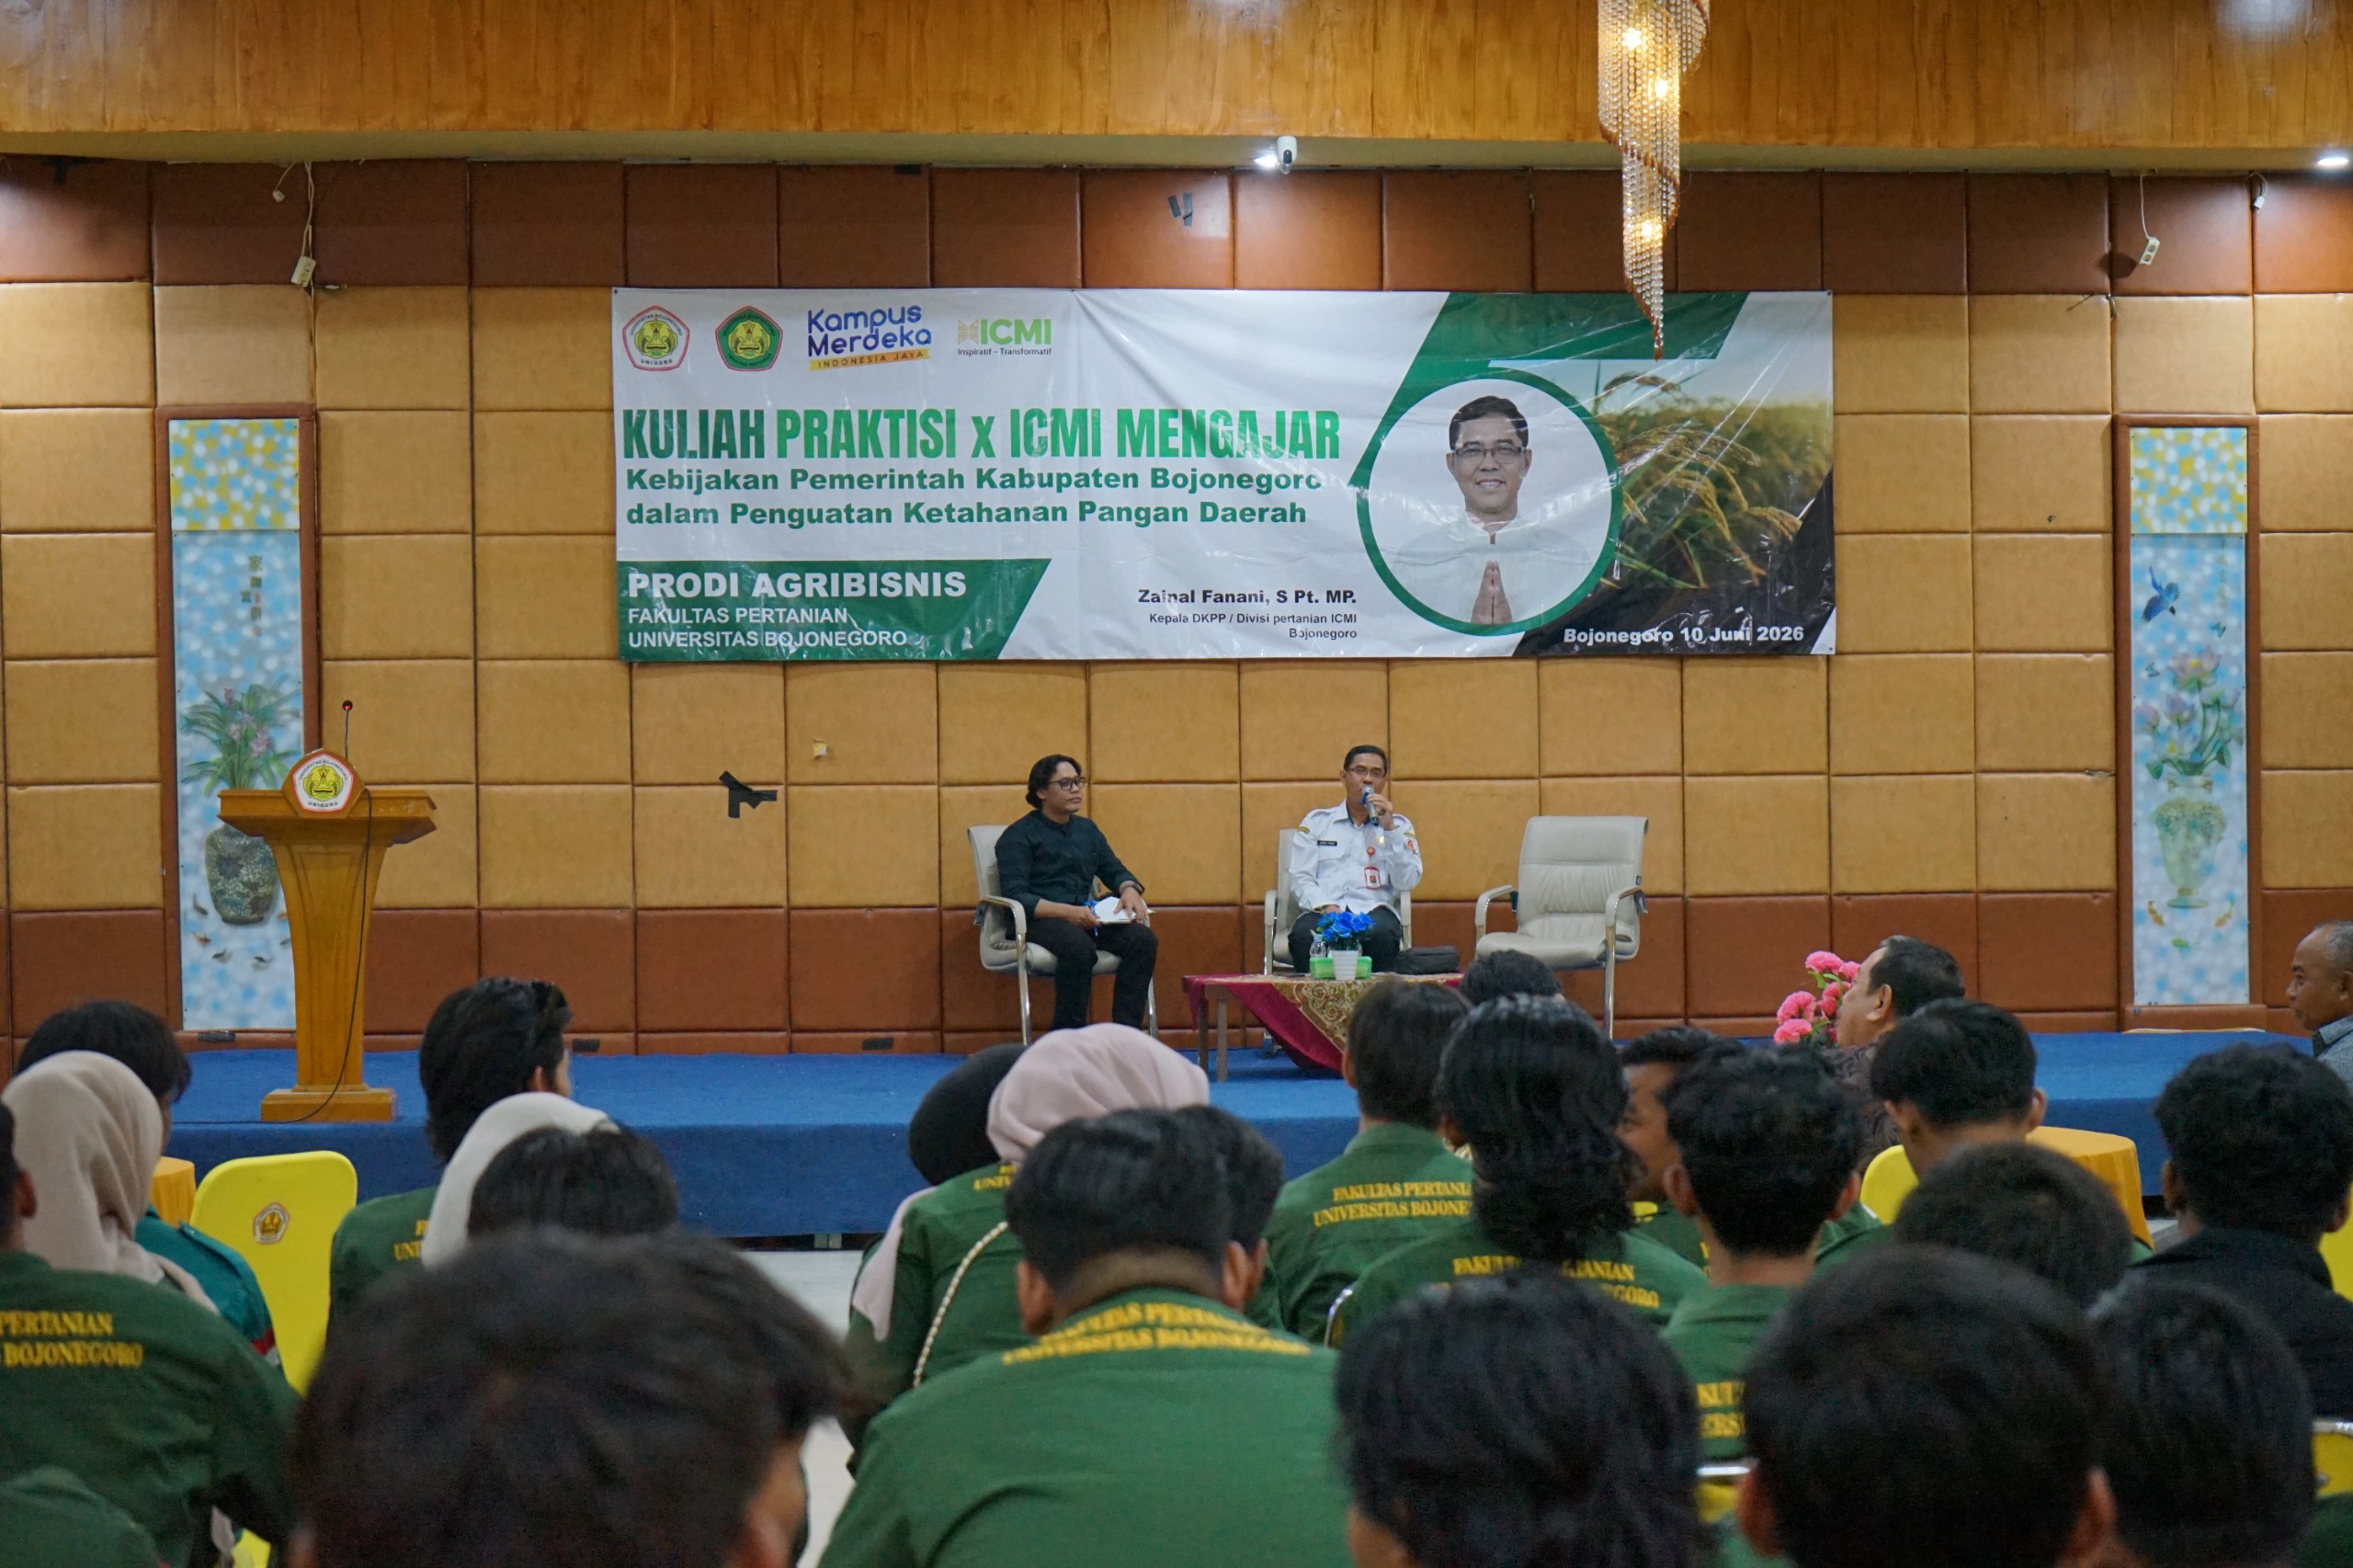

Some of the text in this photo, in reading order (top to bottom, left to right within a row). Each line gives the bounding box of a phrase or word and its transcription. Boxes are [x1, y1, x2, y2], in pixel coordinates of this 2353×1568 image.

[807, 305, 922, 334] Kampus
[807, 325, 932, 357] Merdeka
[980, 318, 1051, 345] ICMI
[818, 350, 924, 369] INDONESIA JAYA
[958, 347, 992, 357] Inspiratif
[1000, 347, 1051, 356] Transformatif
[622, 409, 765, 459] KULIAH
[777, 408, 956, 459] PRAKTISI
[1011, 407, 1100, 459] ICMI
[1116, 408, 1340, 459] MENGAJAR
[626, 467, 1322, 495] Kebijakan Pemerintah Kabupaten Bojonegoro
[626, 500, 1306, 529] dalam Penguatan Ketahanan Pangan Daerah
[628, 571, 966, 597] PRODI AGRIBISNIS
[1138, 589, 1357, 606] Zainal Fanani, S Pt. MP.
[628, 608, 847, 624] FAKULTAS PERTANIAN
[1150, 613, 1188, 625] Kepala
[1192, 613, 1226, 623] DKPP
[1236, 613, 1269, 623] Divisi
[1273, 613, 1326, 625] pertanian
[1332, 613, 1357, 623] ICMI
[628, 631, 907, 647] UNIVERSITAS BOJONEGORO
[1289, 628, 1357, 640] Bojonegoro
[1563, 626, 1804, 645] Bojonegoro 10 Juni 2026
[1333, 1182, 1402, 1201] FAKULTAS
[1313, 1201, 1408, 1228] UNIVERSITAS
[4, 1341, 143, 1369] BOJONEGORO
